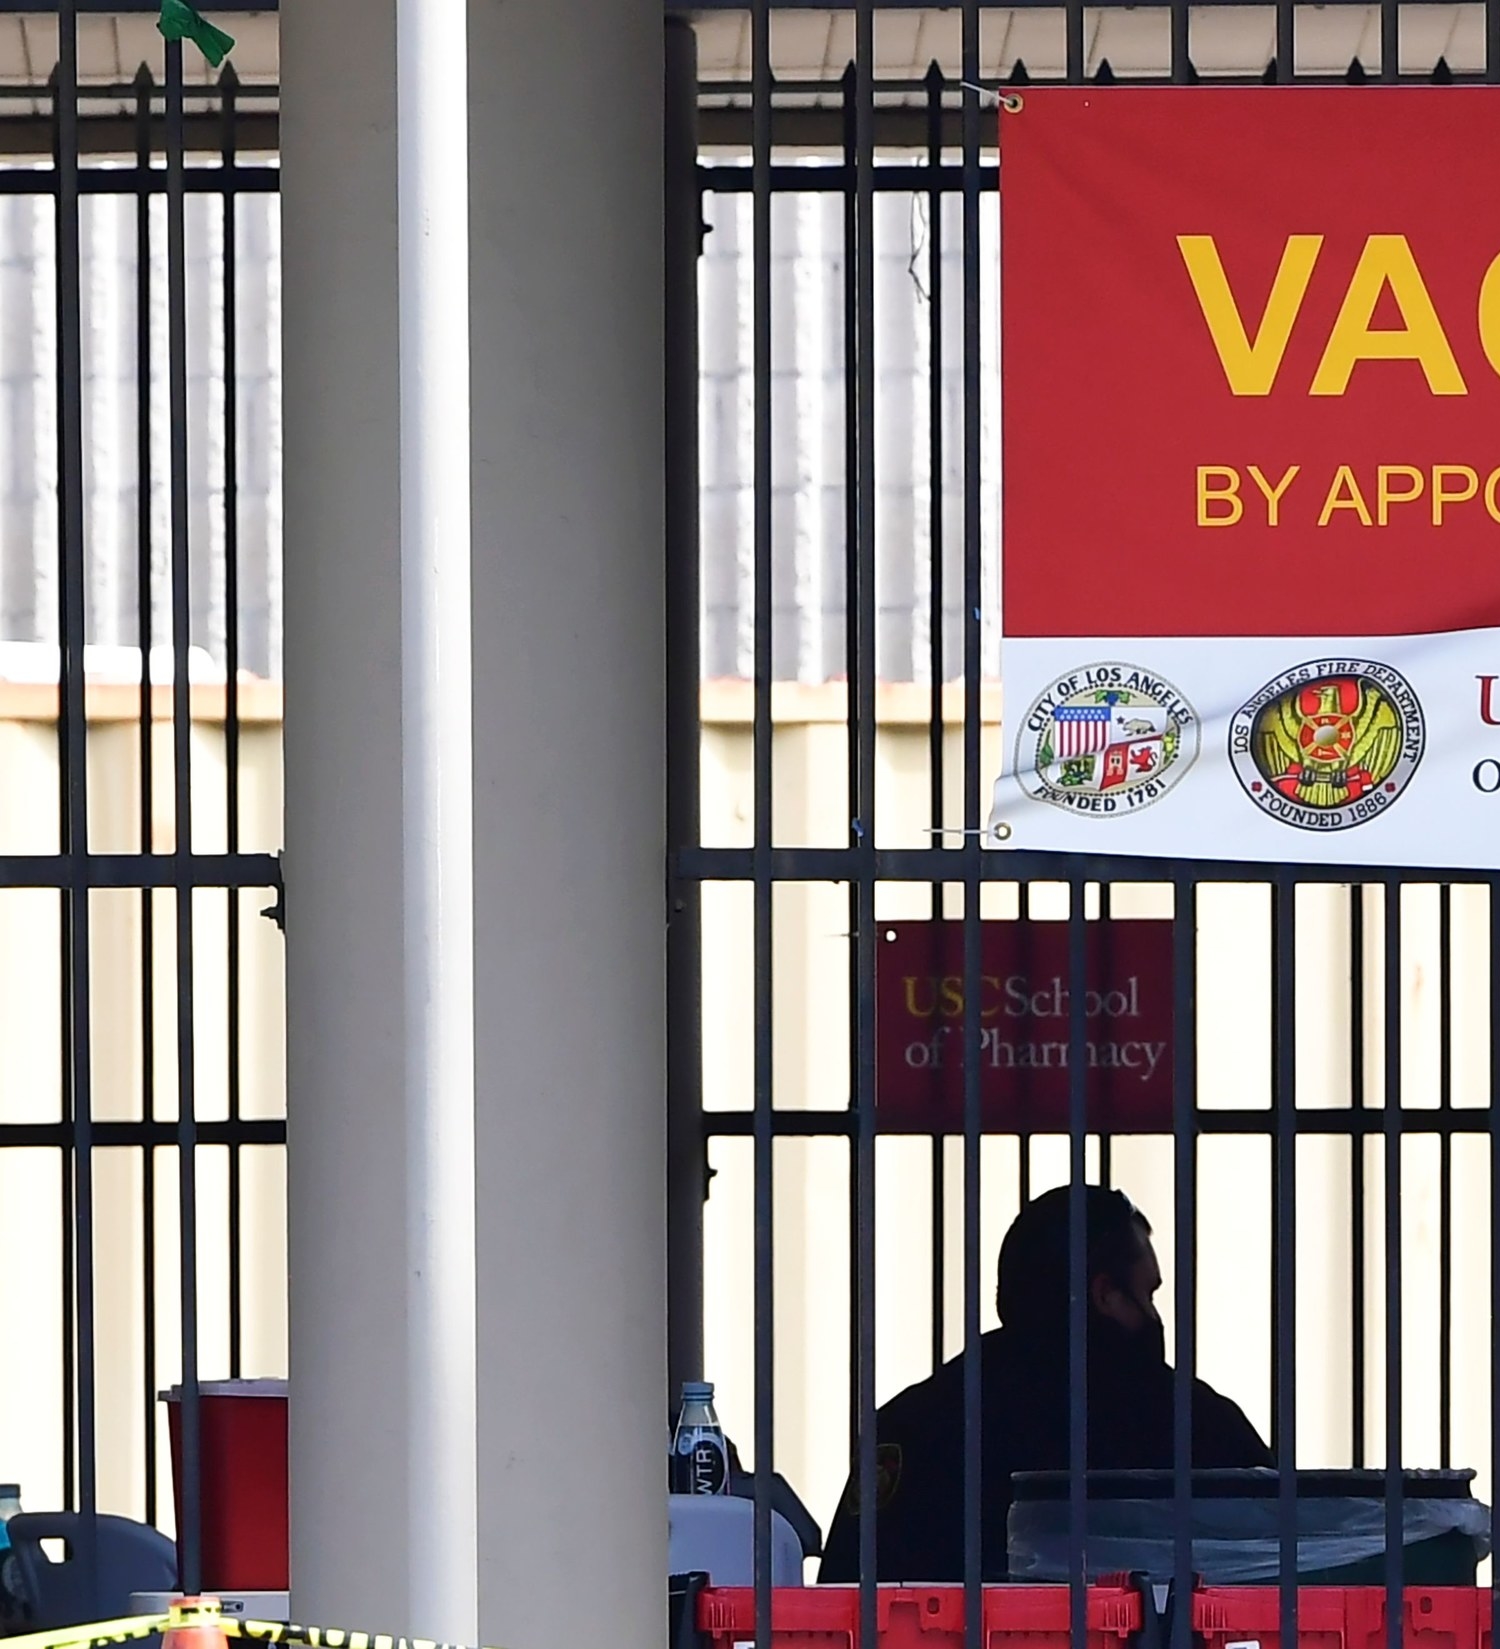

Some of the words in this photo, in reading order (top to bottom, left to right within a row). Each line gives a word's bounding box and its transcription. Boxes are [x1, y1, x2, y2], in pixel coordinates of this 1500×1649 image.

[1195, 464, 1300, 527] BY
[1316, 662, 1361, 676] FIRE
[1027, 692, 1058, 733] CITY
[1057, 675, 1079, 697] OF
[1086, 667, 1122, 684] LOS
[1127, 671, 1194, 726] ANGELES
[1241, 667, 1312, 719] ANGELES
[1363, 664, 1421, 764] DEPARTMENT
[1234, 724, 1249, 754] LOS
[1127, 777, 1167, 807] 1781
[1258, 788, 1342, 827] FOUNDED
[1349, 791, 1387, 821] 1886
[903, 975, 1000, 1018] USC
[904, 1026, 951, 1069] of
[697, 1448, 713, 1495] WTR
